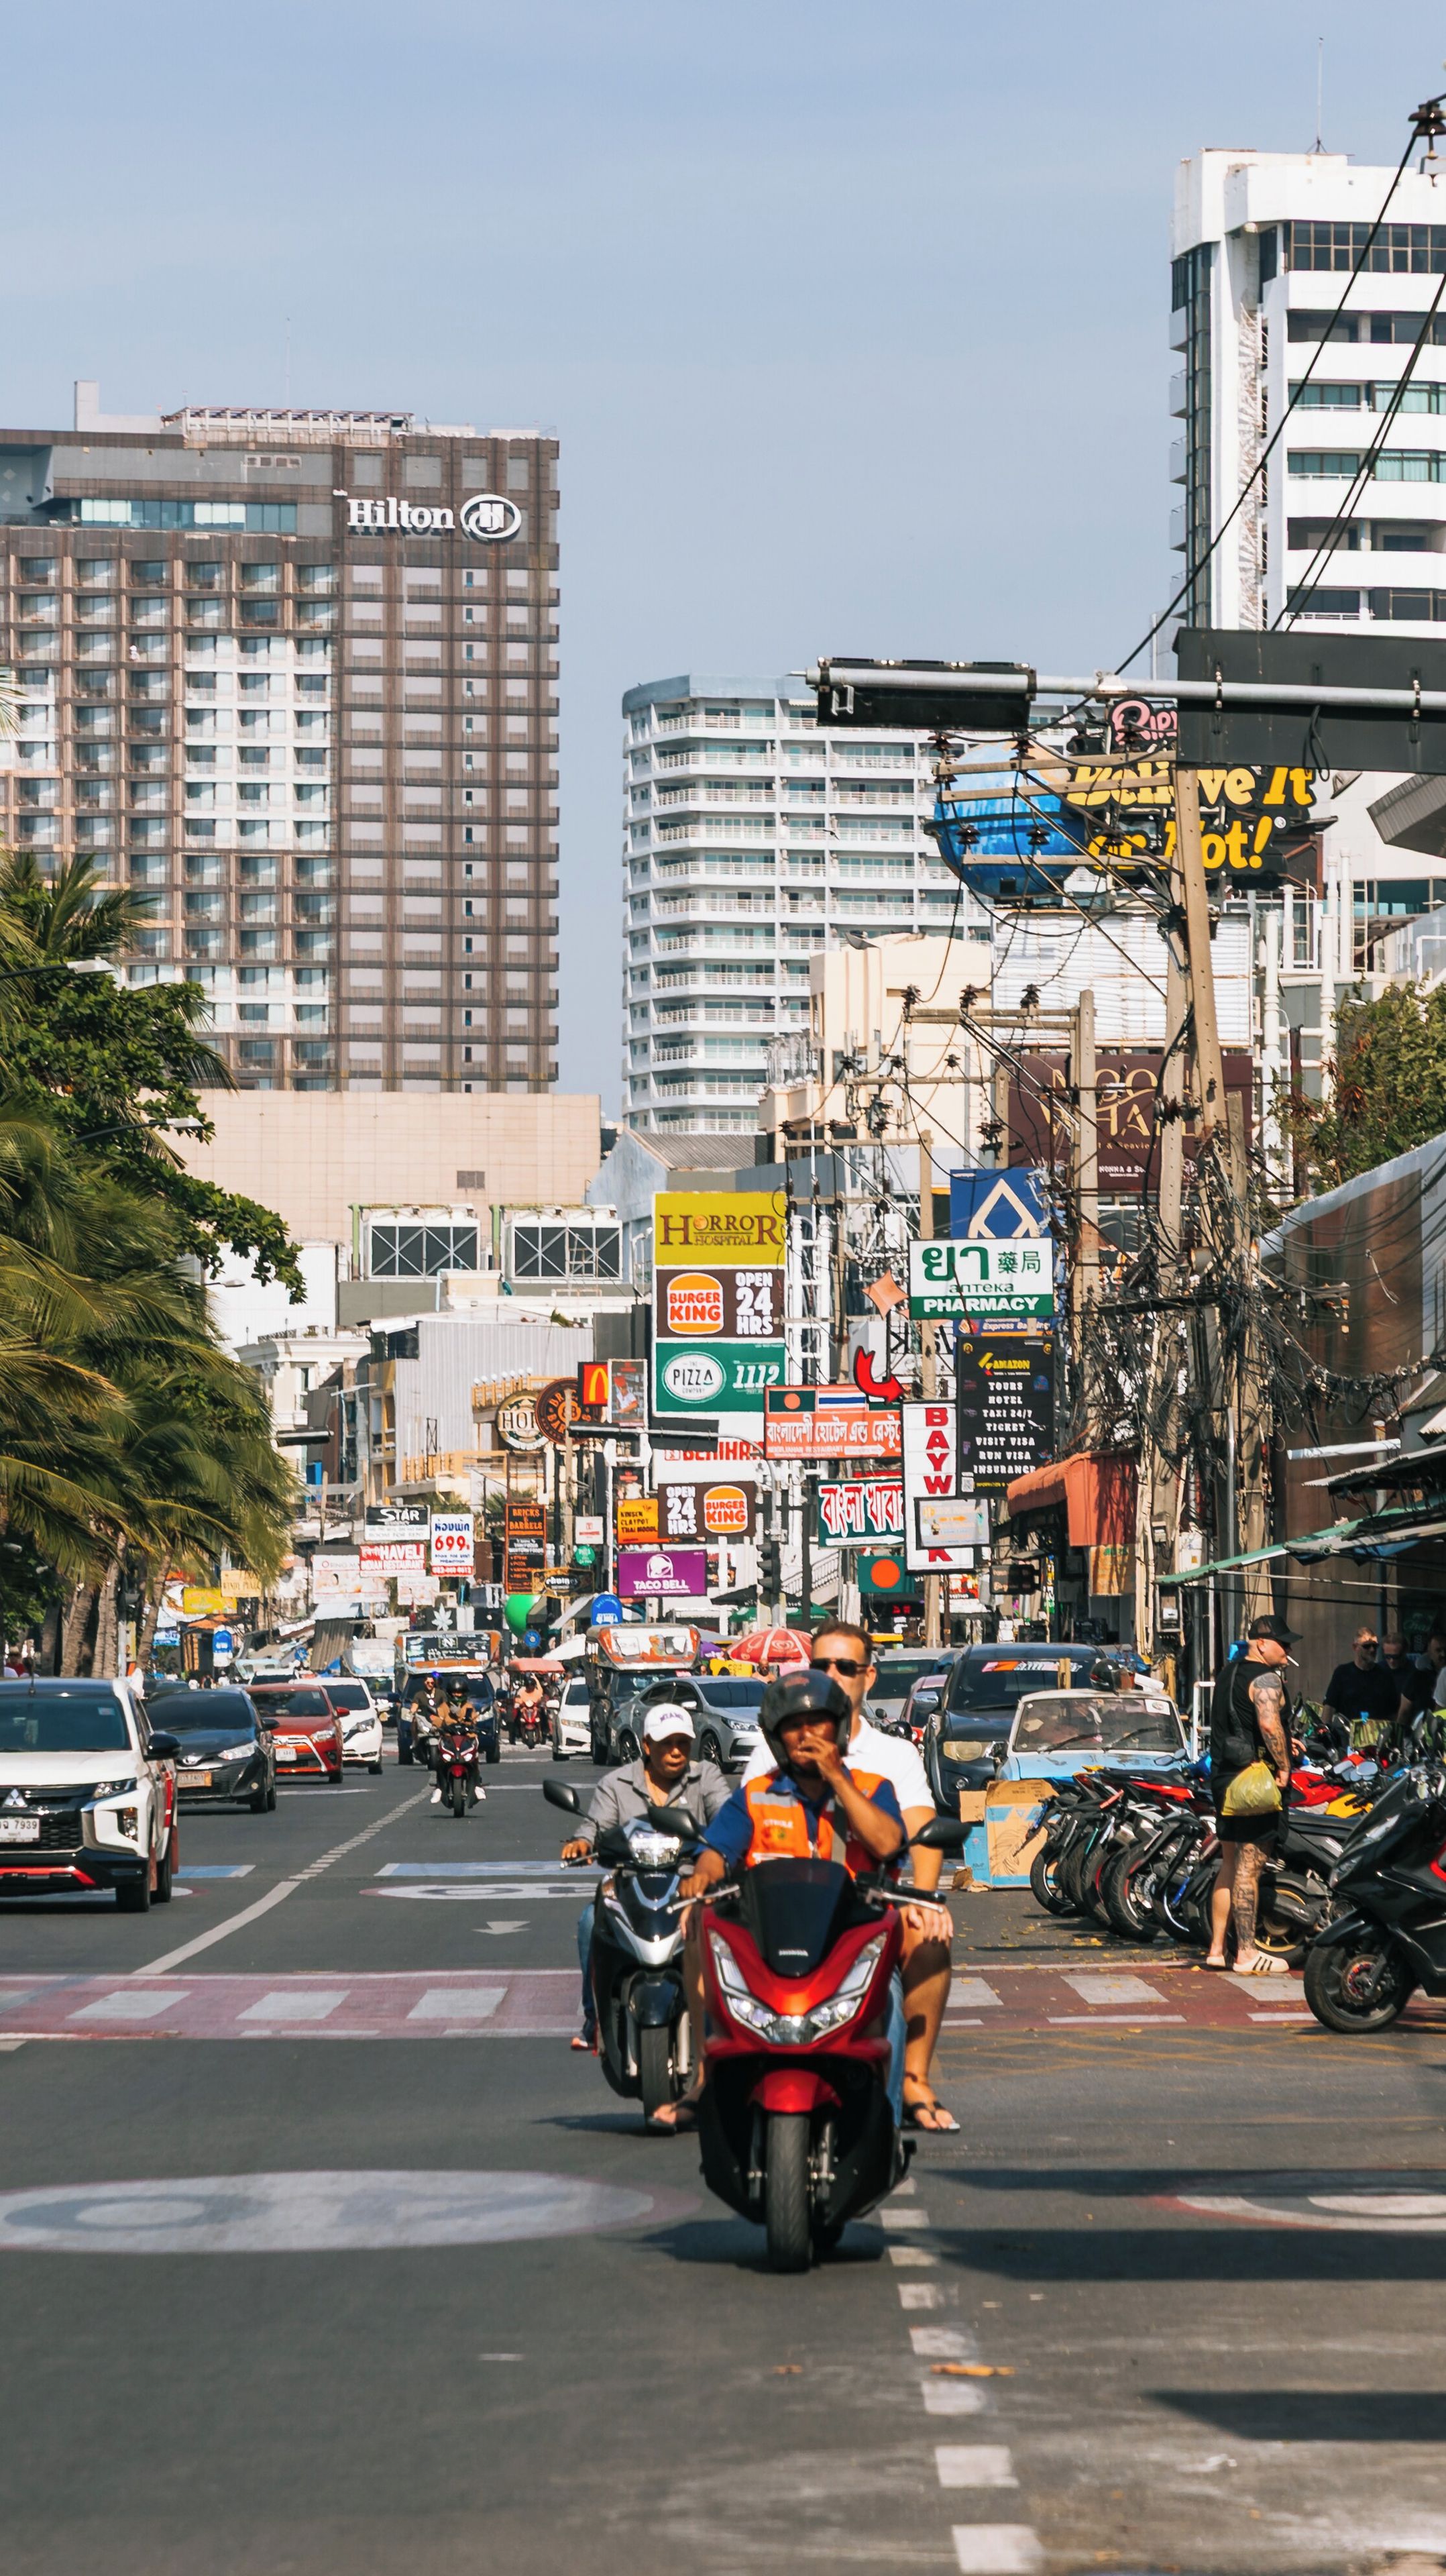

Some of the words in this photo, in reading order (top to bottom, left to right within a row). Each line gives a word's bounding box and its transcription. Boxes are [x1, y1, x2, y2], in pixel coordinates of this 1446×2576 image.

[347, 497, 455, 529] Hilton
[1066, 761, 1256, 806] Belive
[1262, 766, 1313, 805] It
[659, 1215, 782, 1246] HORROR
[694, 1235, 755, 1246] HOSPITAL
[922, 1246, 989, 1281] ยา
[998, 1251, 1041, 1274] 藥局
[735, 1273, 773, 1287] OPEN
[949, 1283, 1014, 1293] аптека
[669, 1292, 720, 1303] BURGER
[736, 1287, 773, 1316] 24
[924, 1297, 1039, 1312] PHARMACY
[670, 1305, 720, 1321] KING
[736, 1316, 773, 1334] HRS
[983, 1322, 1014, 1330] Express
[993, 1360, 1030, 1369] AMAZON
[673, 1369, 714, 1385] PIZZA
[732, 1365, 779, 1389] 1112
[988, 1382, 1023, 1391] TOURS
[988, 1396, 1023, 1404] HOTEL
[983, 1409, 1006, 1417] TAXI
[1010, 1409, 1032, 1419] 24/7
[986, 1423, 1025, 1432] TICKET
[975, 1437, 1005, 1446] VISIT
[1010, 1437, 1035, 1446] VISA
[979, 1451, 1002, 1460] RUN
[1005, 1451, 1031, 1460] VISA
[973, 1465, 1036, 1474] INSURANCE
[667, 1486, 696, 1497] OPEN
[924, 1407, 953, 1562] BAYWK
[667, 1498, 696, 1519] 24
[706, 1501, 744, 1510] BURGER
[867, 1482, 903, 1533] খাবা
[377, 1508, 419, 1522] STAR
[706, 1511, 746, 1523] KING
[668, 1519, 698, 1535] HRS
[379, 1544, 425, 1560] HAVELI
[634, 1580, 661, 1590] TACO
[663, 1579, 689, 1589] BELL
[15, 1819, 38, 1829] 7939
